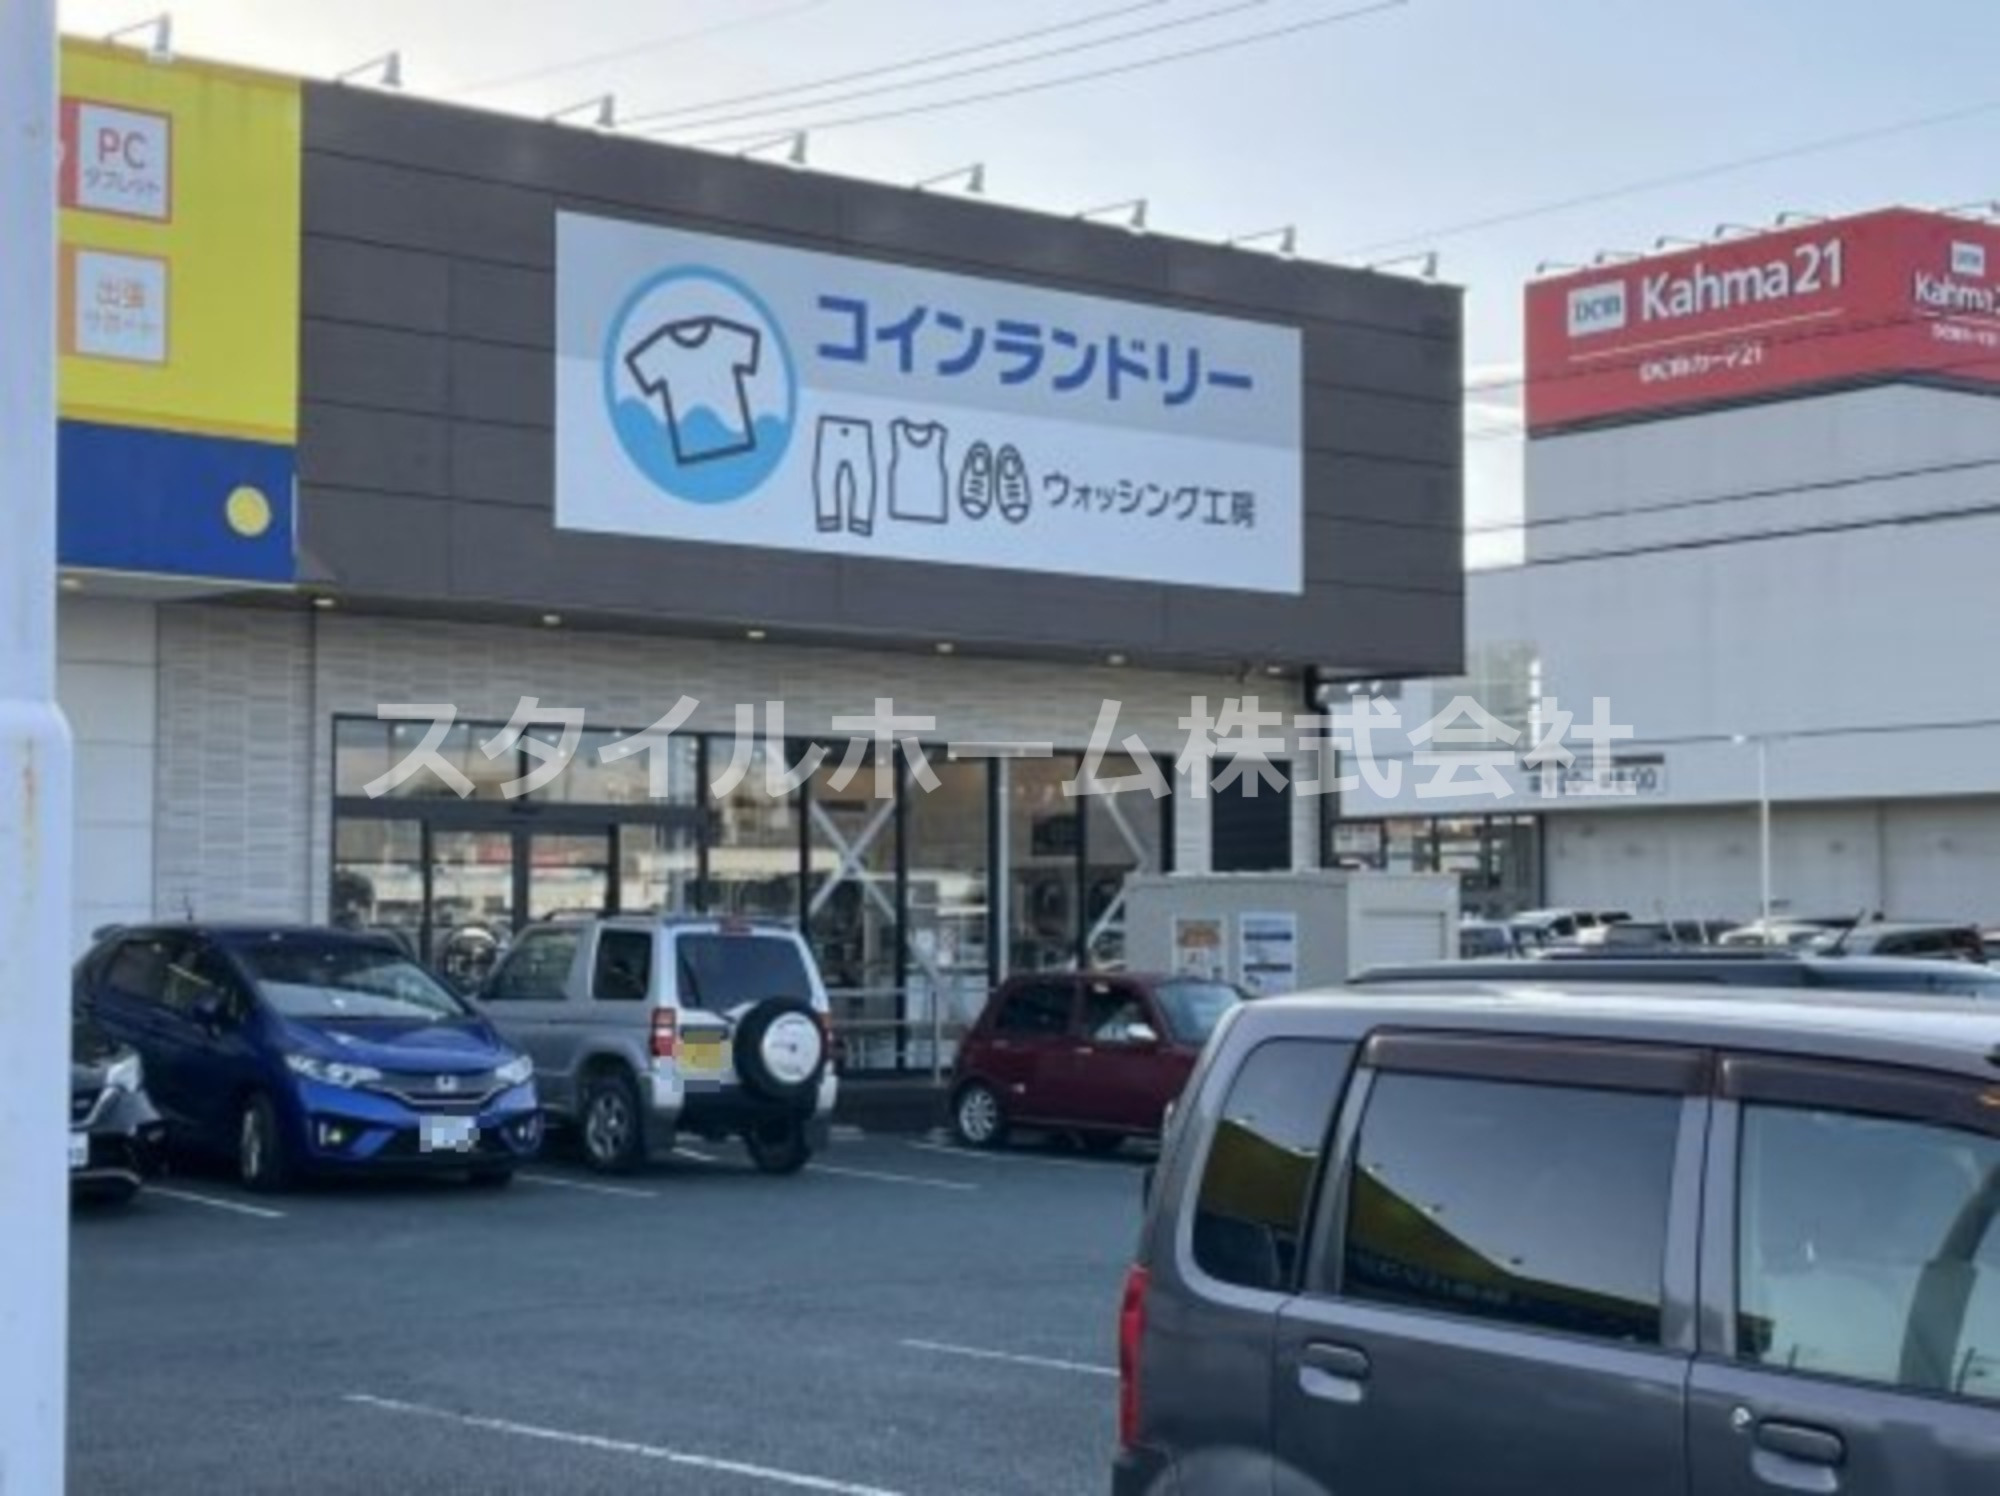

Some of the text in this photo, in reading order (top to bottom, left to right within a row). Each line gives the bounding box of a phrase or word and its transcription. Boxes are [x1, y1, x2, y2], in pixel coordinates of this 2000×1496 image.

[97, 127, 147, 170] PC
[817, 294, 1254, 405] コインランドリー
[1043, 471, 1255, 529] ウォッシング工房
